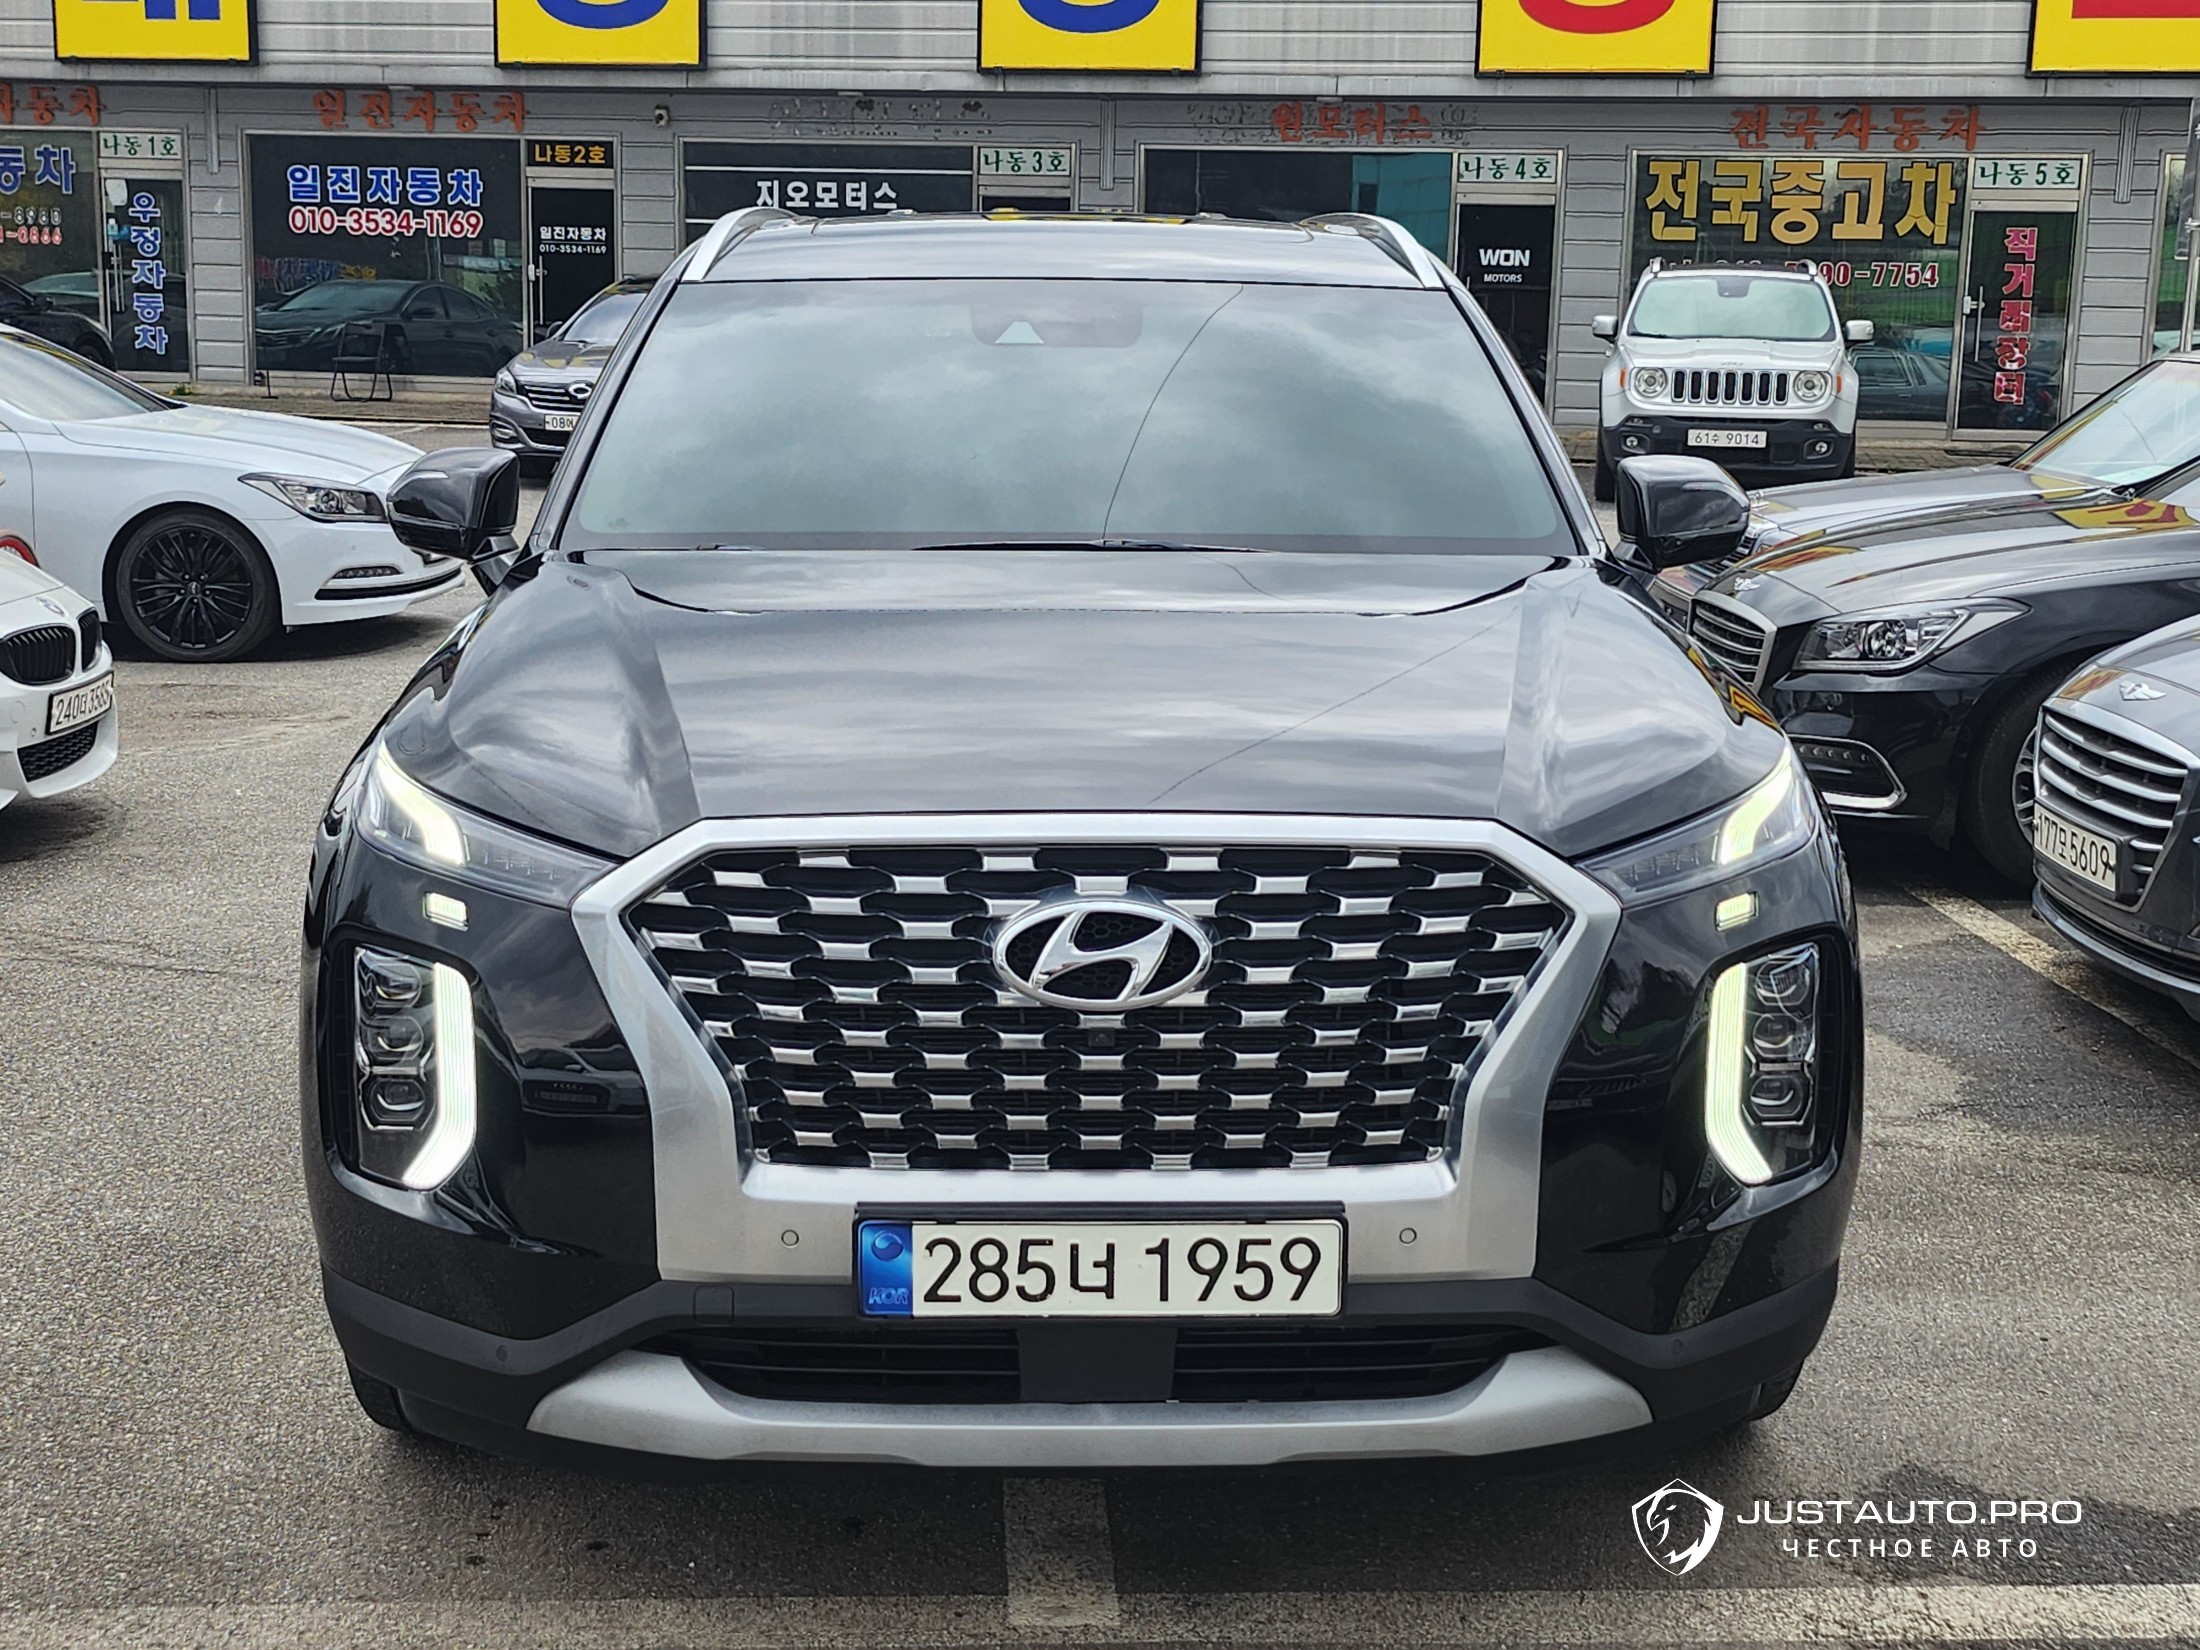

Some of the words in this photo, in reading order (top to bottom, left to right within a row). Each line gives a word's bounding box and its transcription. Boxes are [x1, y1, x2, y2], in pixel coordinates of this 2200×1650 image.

[312, 88, 529, 132] 일진자동차
[1729, 104, 1985, 150] 전국자동차
[535, 144, 606, 163] 나동2호
[287, 164, 483, 206] 일진자동차
[756, 180, 898, 210] 지오모터스
[1645, 160, 1956, 245] 전국중고차
[289, 206, 483, 238] 010-3534-1169
[540, 226, 606, 241] 일진자동차
[539, 244, 606, 254] 010-3534-1169
[1479, 249, 1530, 266] WON
[129, 192, 168, 354] 우정자동차
[1484, 274, 1522, 283] MOTORS
[1726, 433, 1759, 445] 9014
[923, 1237, 1115, 1303] 285너
[1146, 1237, 1322, 1302] 1959
[868, 1287, 909, 1304] KOR
